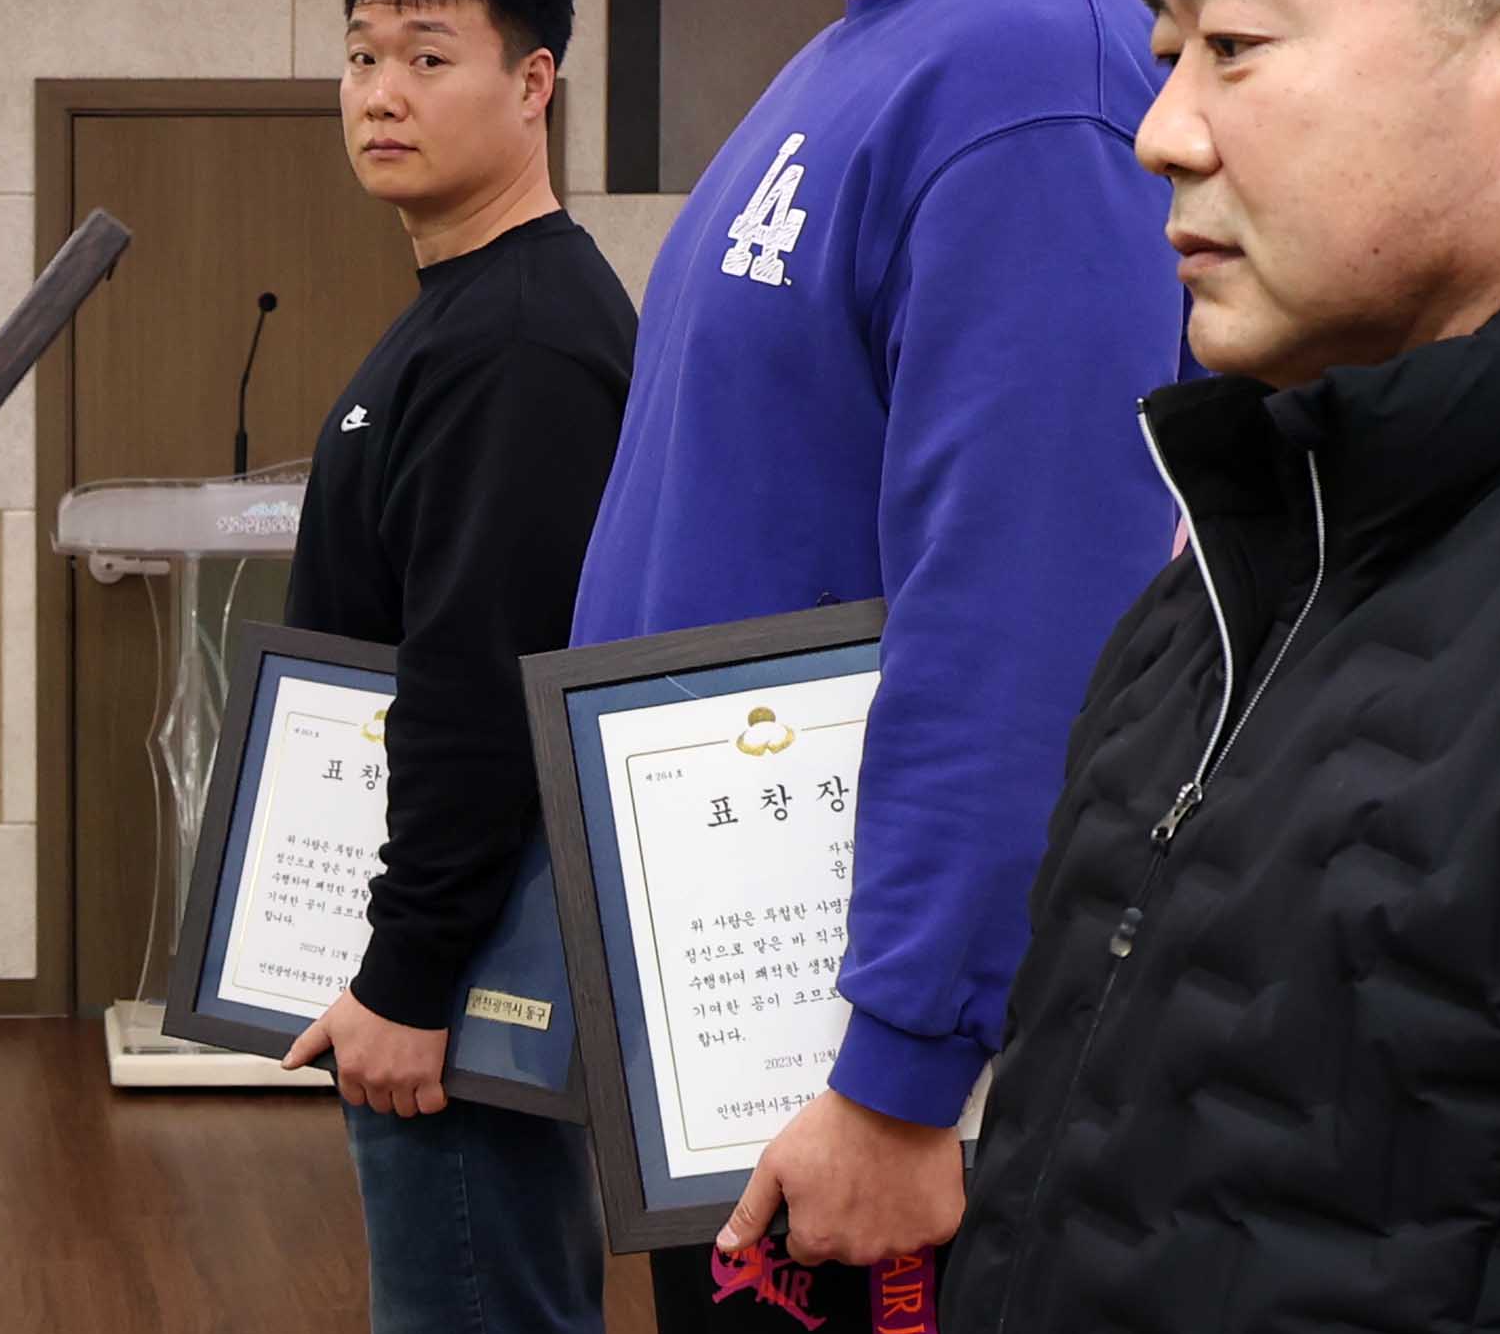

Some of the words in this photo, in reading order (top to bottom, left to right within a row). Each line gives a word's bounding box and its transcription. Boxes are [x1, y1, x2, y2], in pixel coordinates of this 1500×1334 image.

[721, 133, 807, 286] LA
[713, 910, 756, 930] 사람은
[815, 897, 849, 914] 사명
[685, 941, 744, 964] 정신으로
[689, 969, 745, 991] 수행하여
[808, 955, 843, 975] 생활
[692, 999, 739, 1019] 기여한
[751, 993, 781, 1012] 공이
[881, 1253, 925, 1319] AIR
